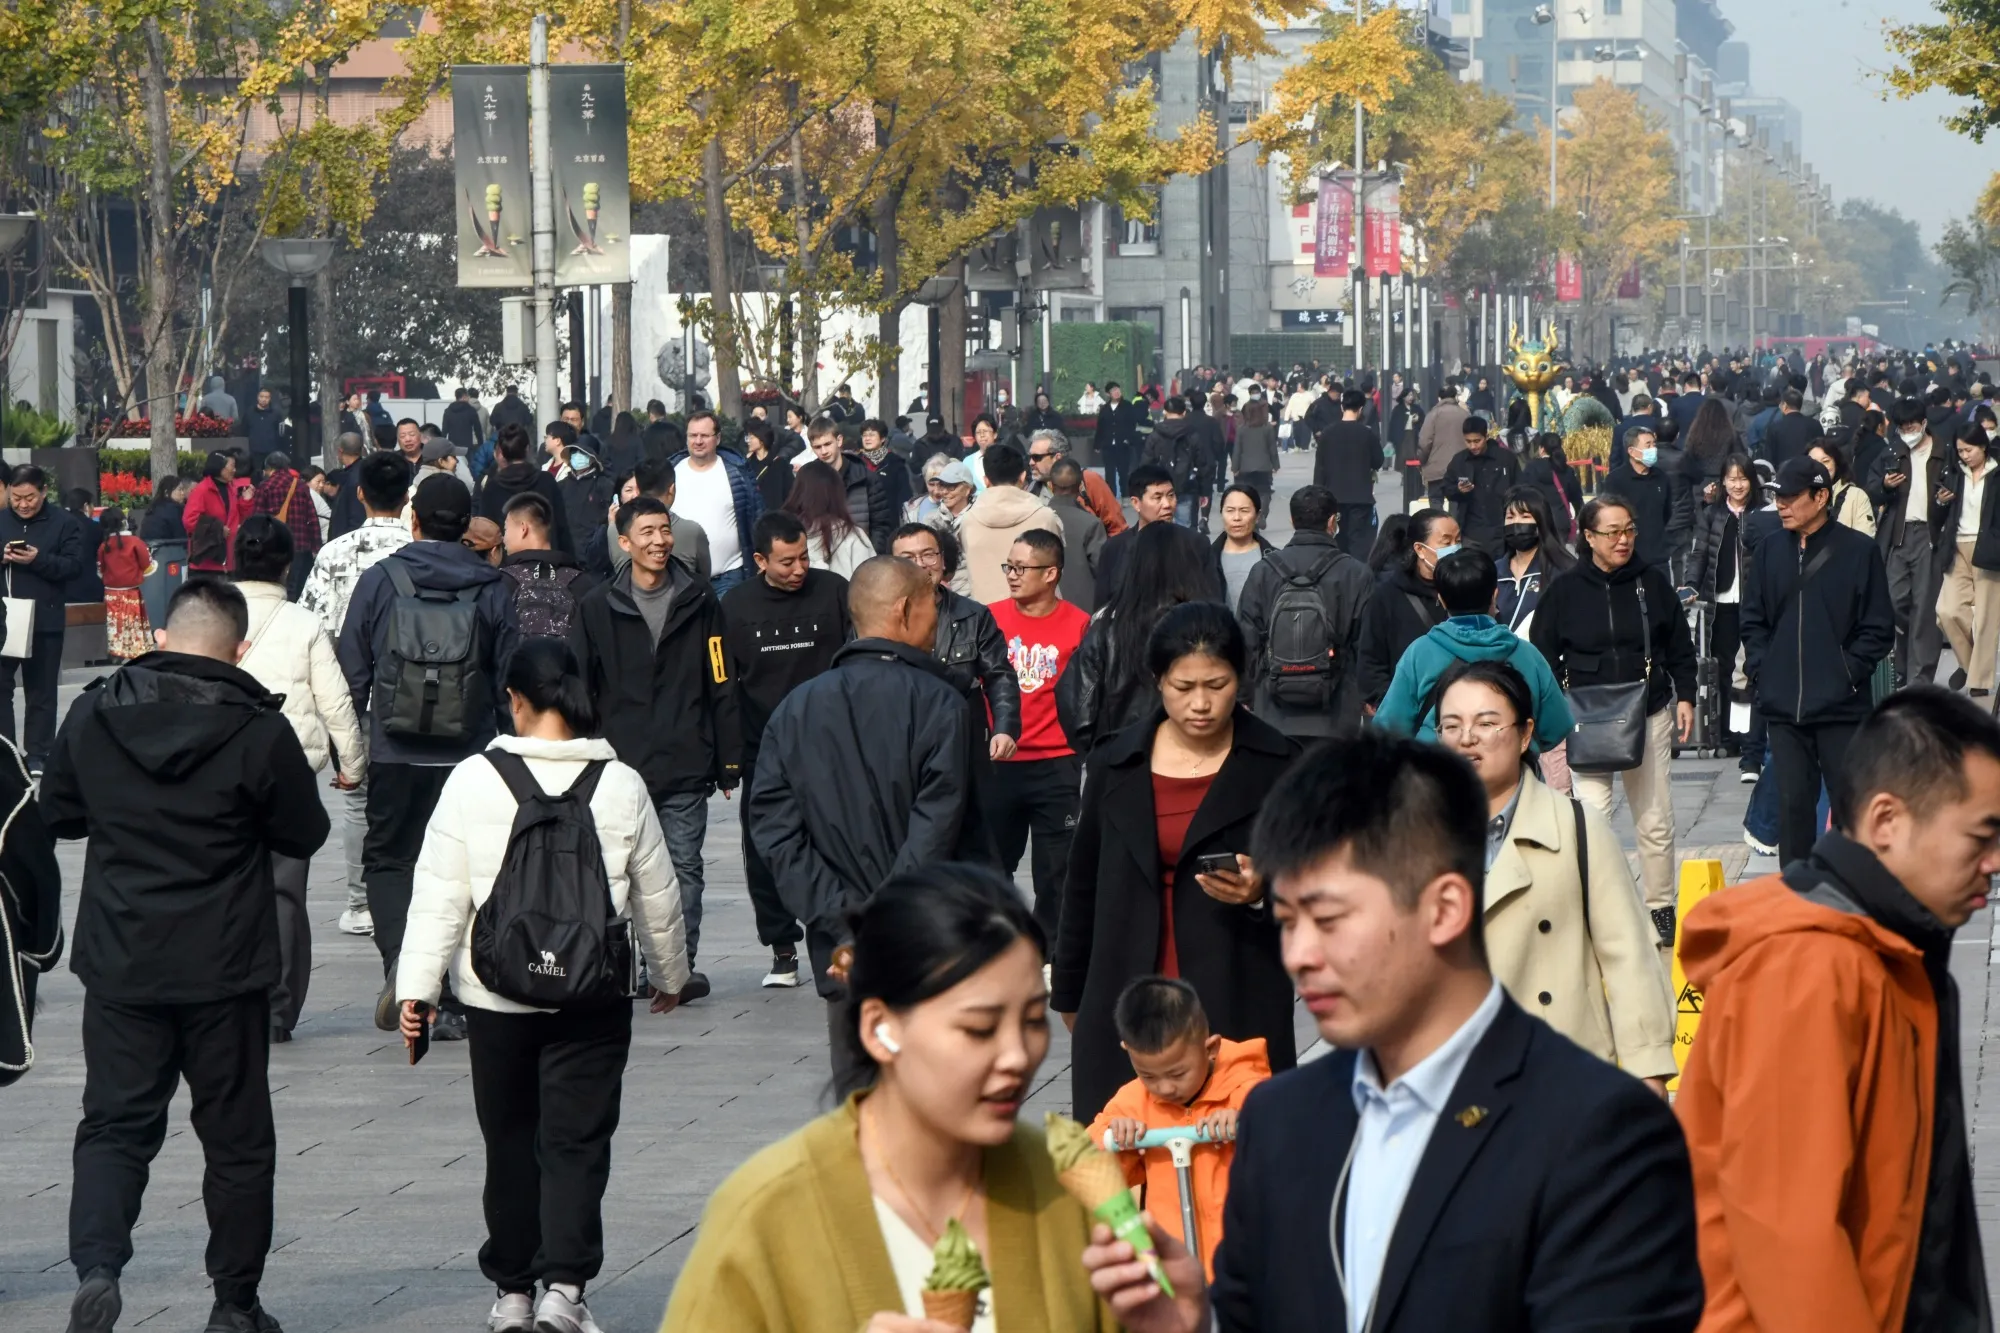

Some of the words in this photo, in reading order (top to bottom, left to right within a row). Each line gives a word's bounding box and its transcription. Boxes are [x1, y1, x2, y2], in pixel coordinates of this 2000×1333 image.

[760, 644, 790, 652] ANYTHING
[790, 641, 815, 649] POSSIBLE
[528, 962, 567, 977] CAMEL
